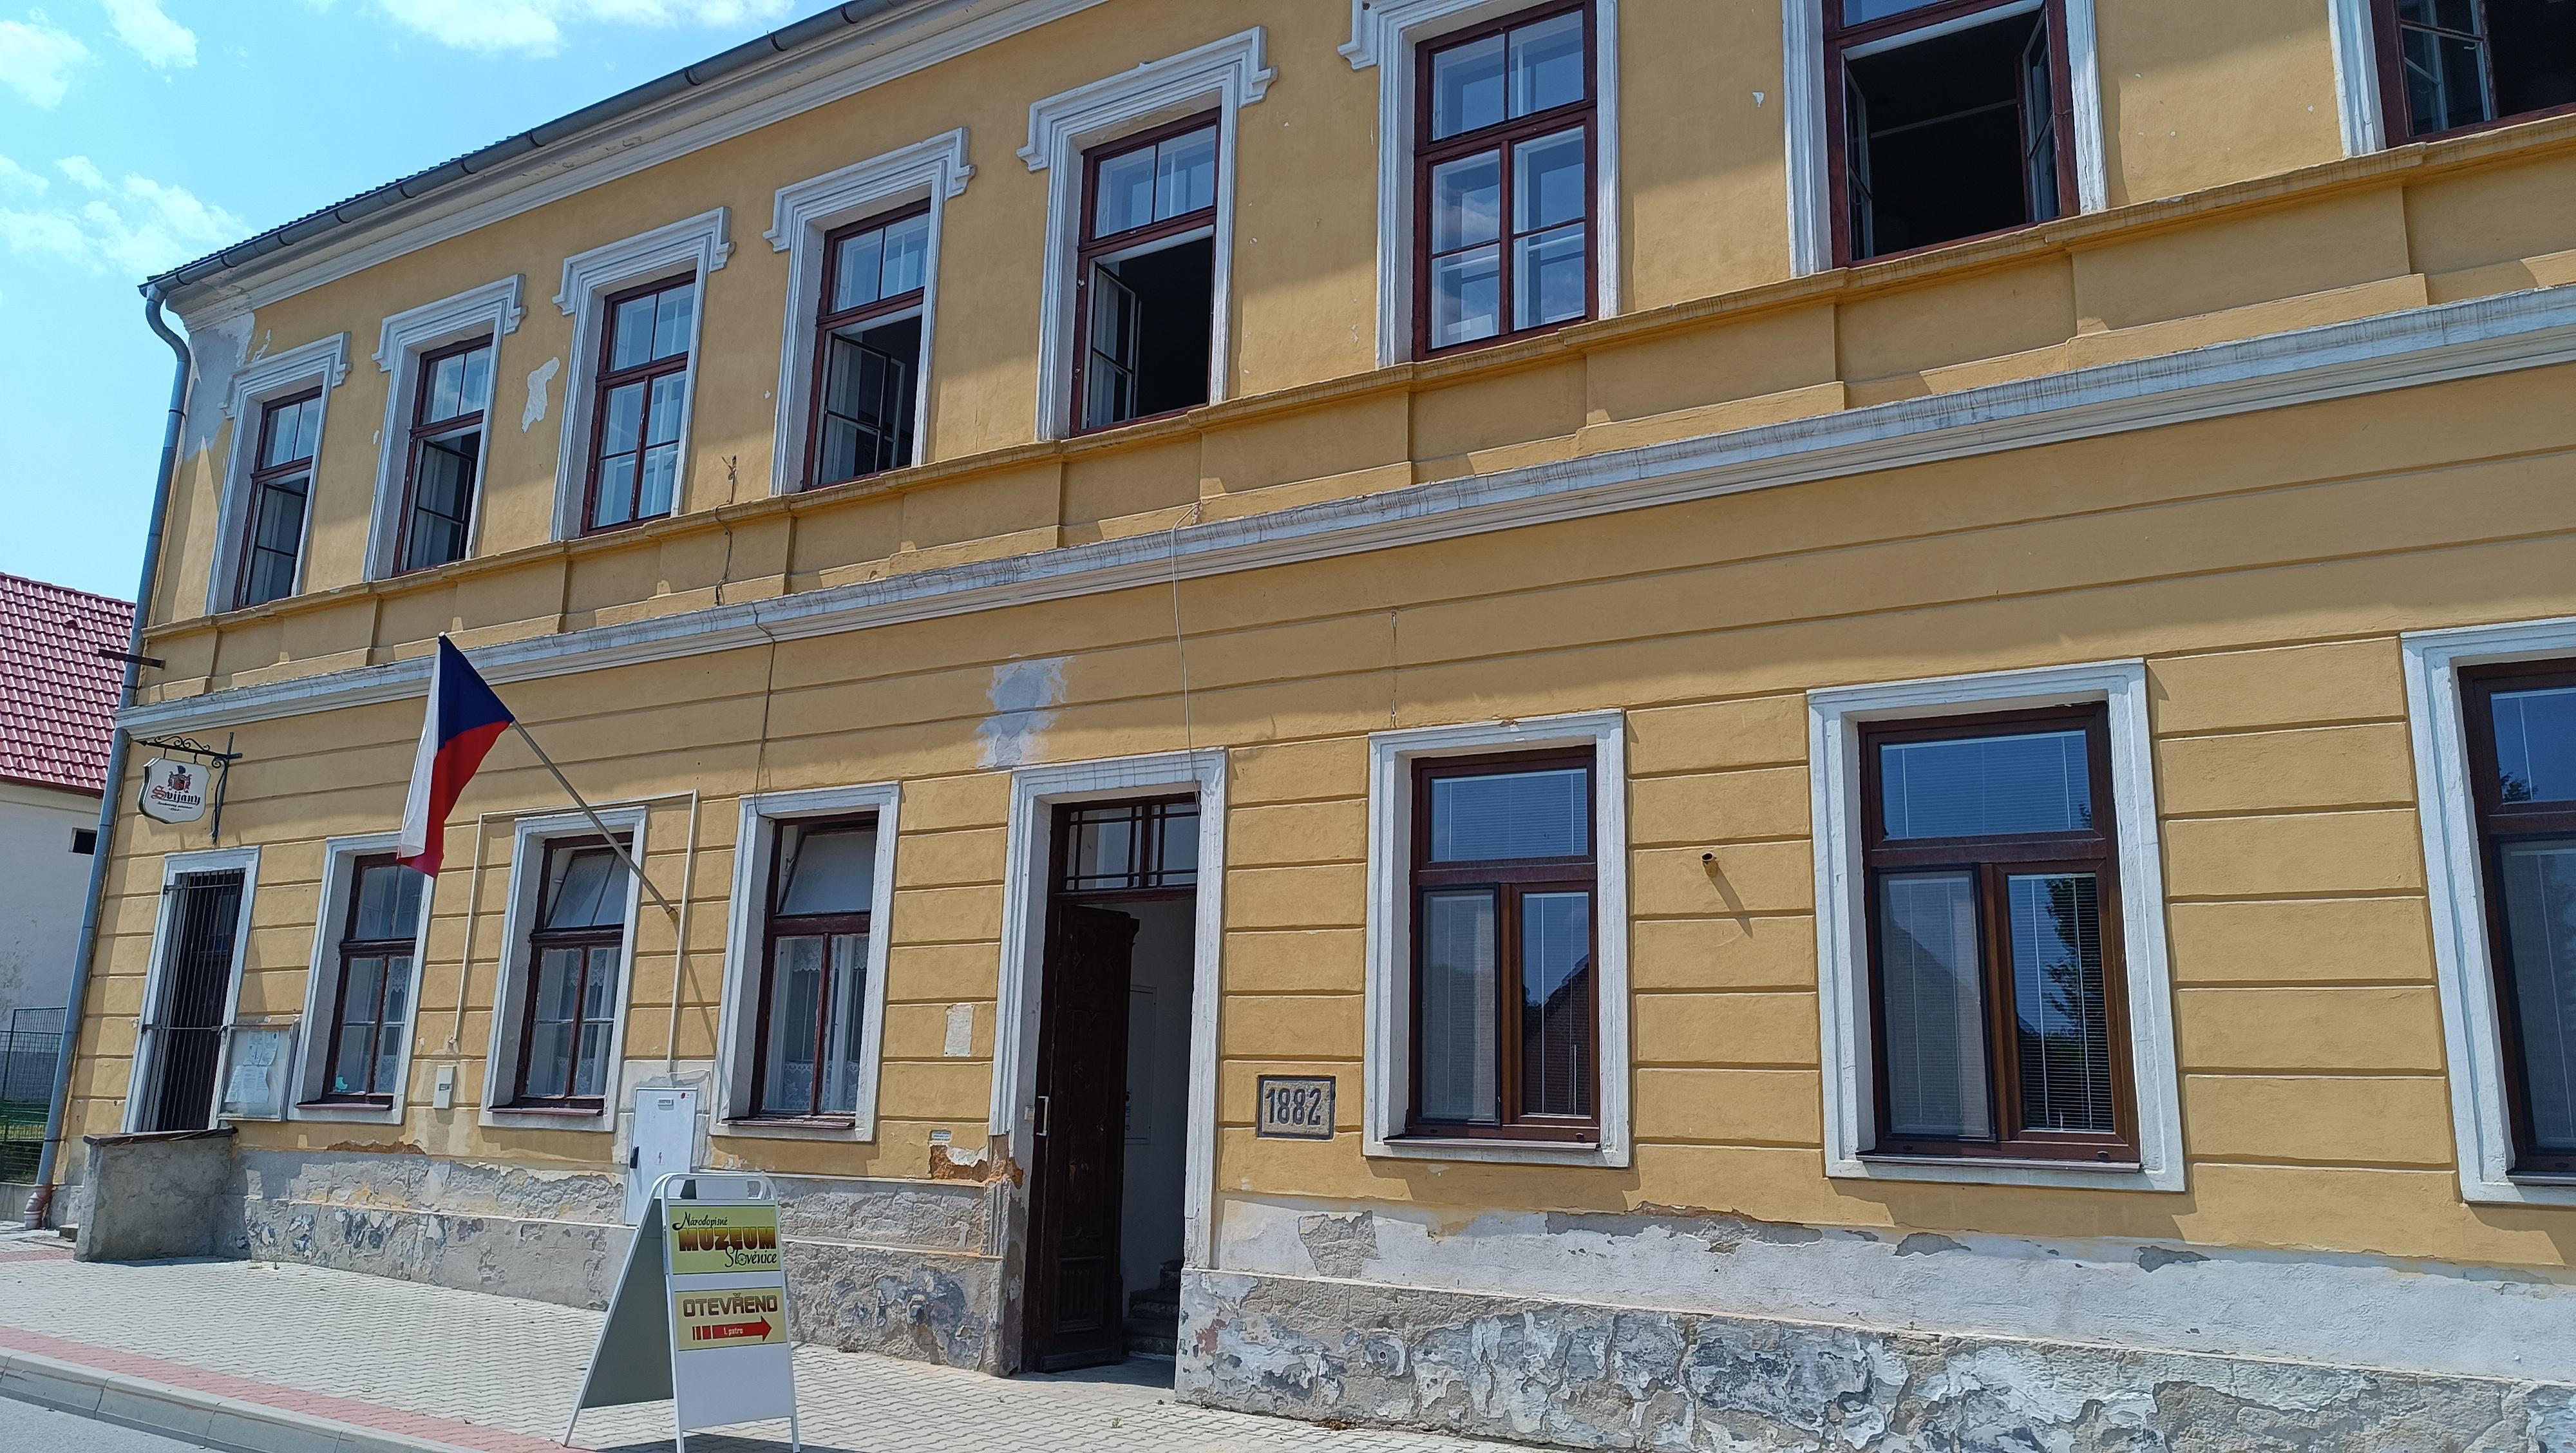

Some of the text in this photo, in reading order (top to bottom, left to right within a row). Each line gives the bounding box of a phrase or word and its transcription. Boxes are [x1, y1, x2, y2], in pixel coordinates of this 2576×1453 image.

[151, 785, 201, 805] Svijany
[1265, 1088, 1321, 1125] 1882
[672, 1211, 728, 1230] Národopisné
[679, 1226, 777, 1251] MUZEUM
[724, 1246, 777, 1268] Slověnice
[683, 1293, 778, 1317] OTEVŘENO
[728, 1327, 743, 1336] patro
